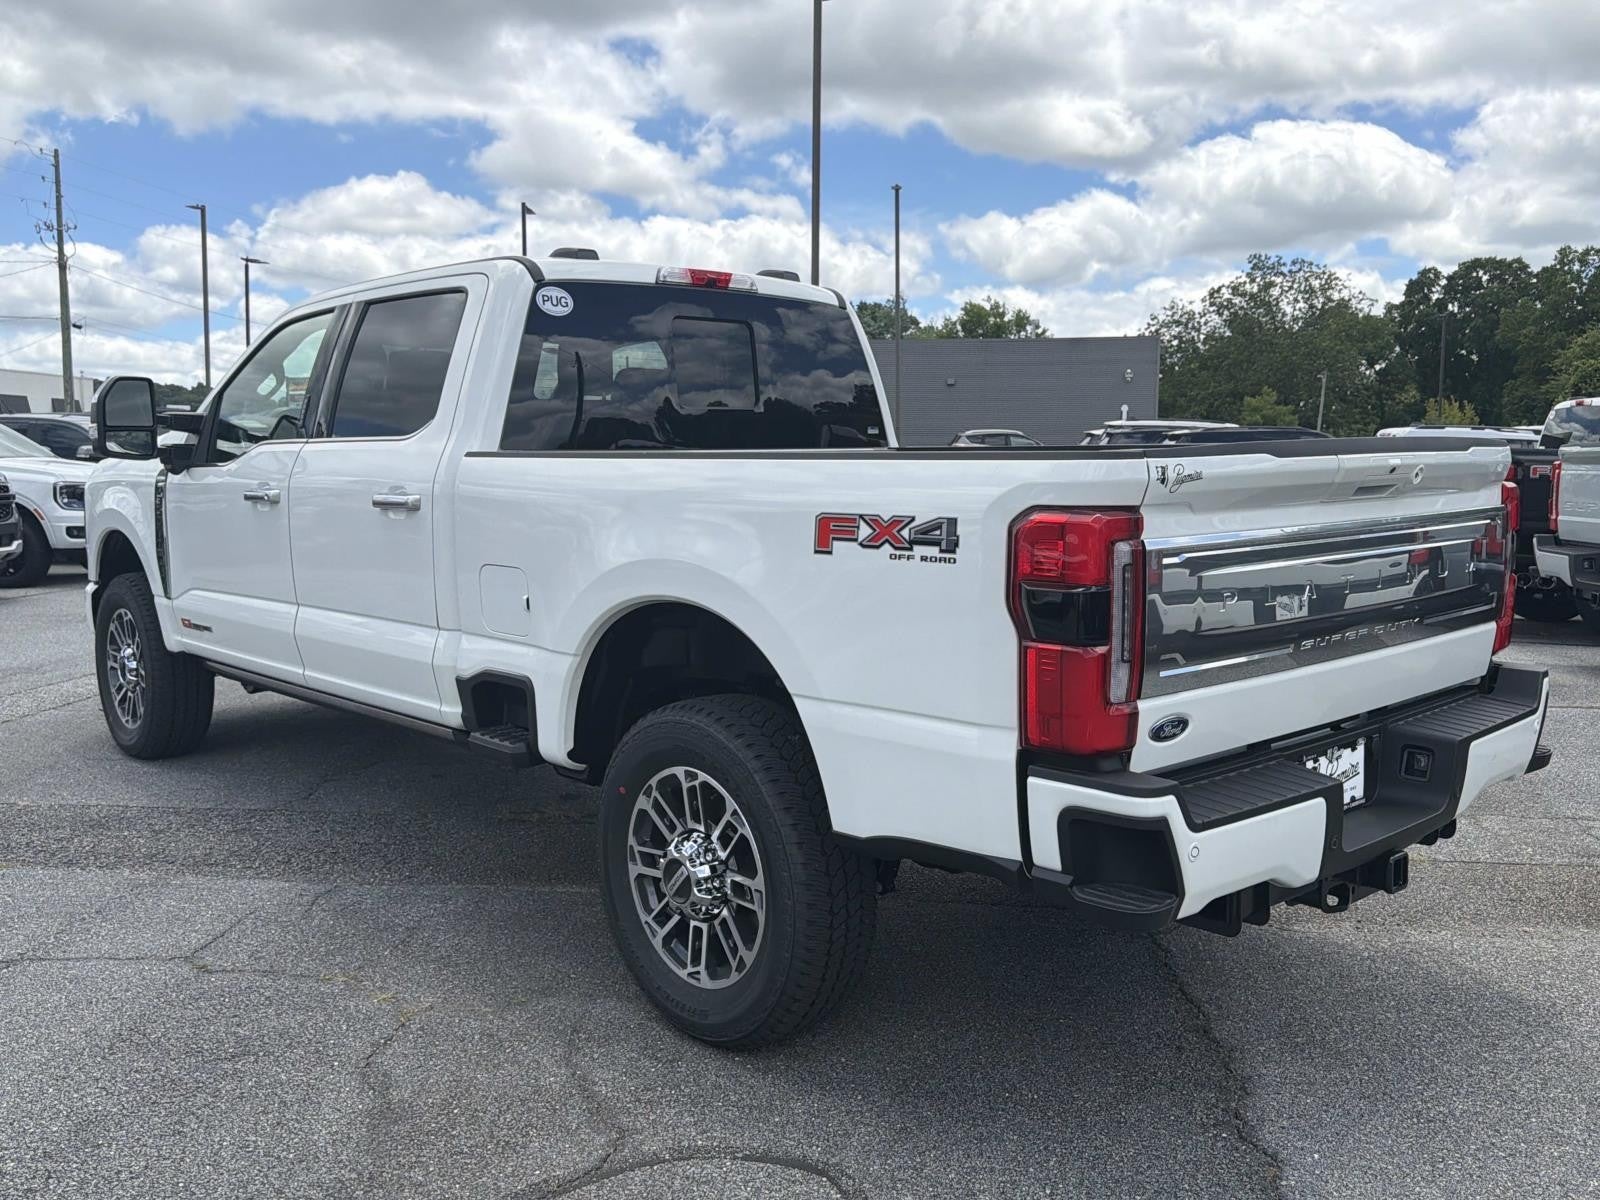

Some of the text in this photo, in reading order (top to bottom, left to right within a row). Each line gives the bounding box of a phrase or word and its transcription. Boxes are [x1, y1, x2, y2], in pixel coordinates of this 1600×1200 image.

[541, 294, 569, 308] PUG
[814, 512, 959, 555] FX4
[889, 553, 957, 564] OFF ROAD
[1300, 617, 1421, 650] SUPER DUTY
